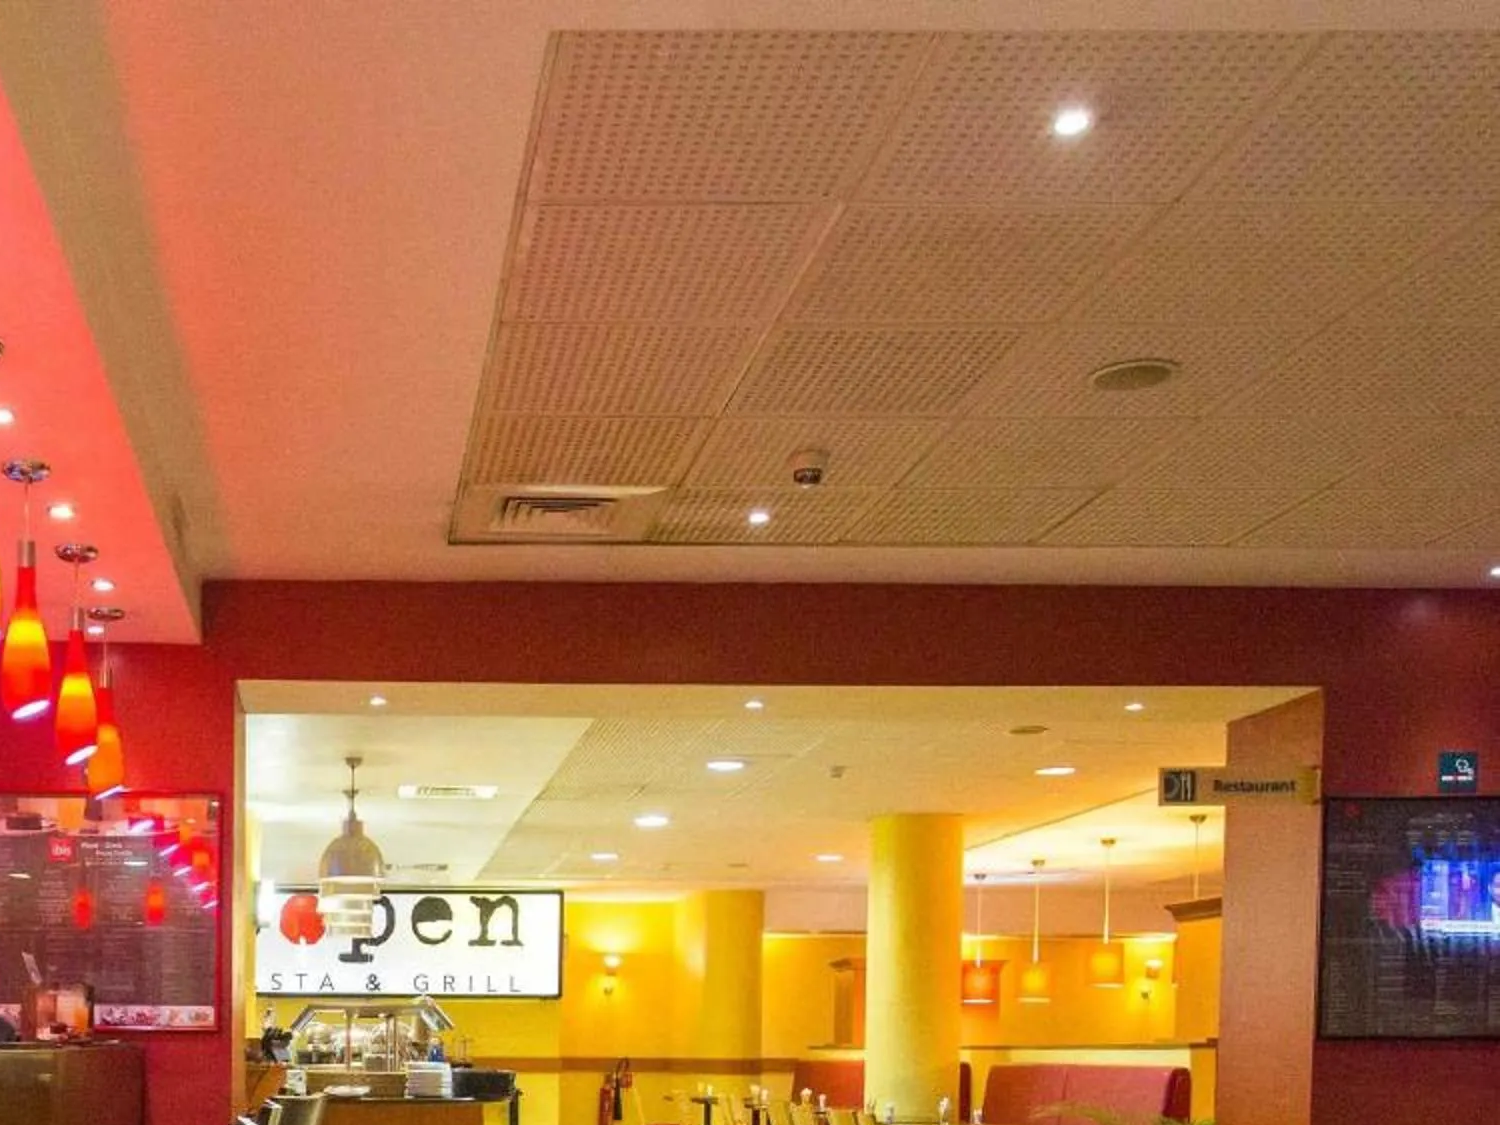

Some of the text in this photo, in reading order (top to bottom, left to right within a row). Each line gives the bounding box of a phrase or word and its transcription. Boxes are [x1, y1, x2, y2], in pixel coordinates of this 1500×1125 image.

[1213, 779, 1296, 793] Restaurant
[365, 974, 382, 992] &
[412, 974, 522, 993] GRILL
